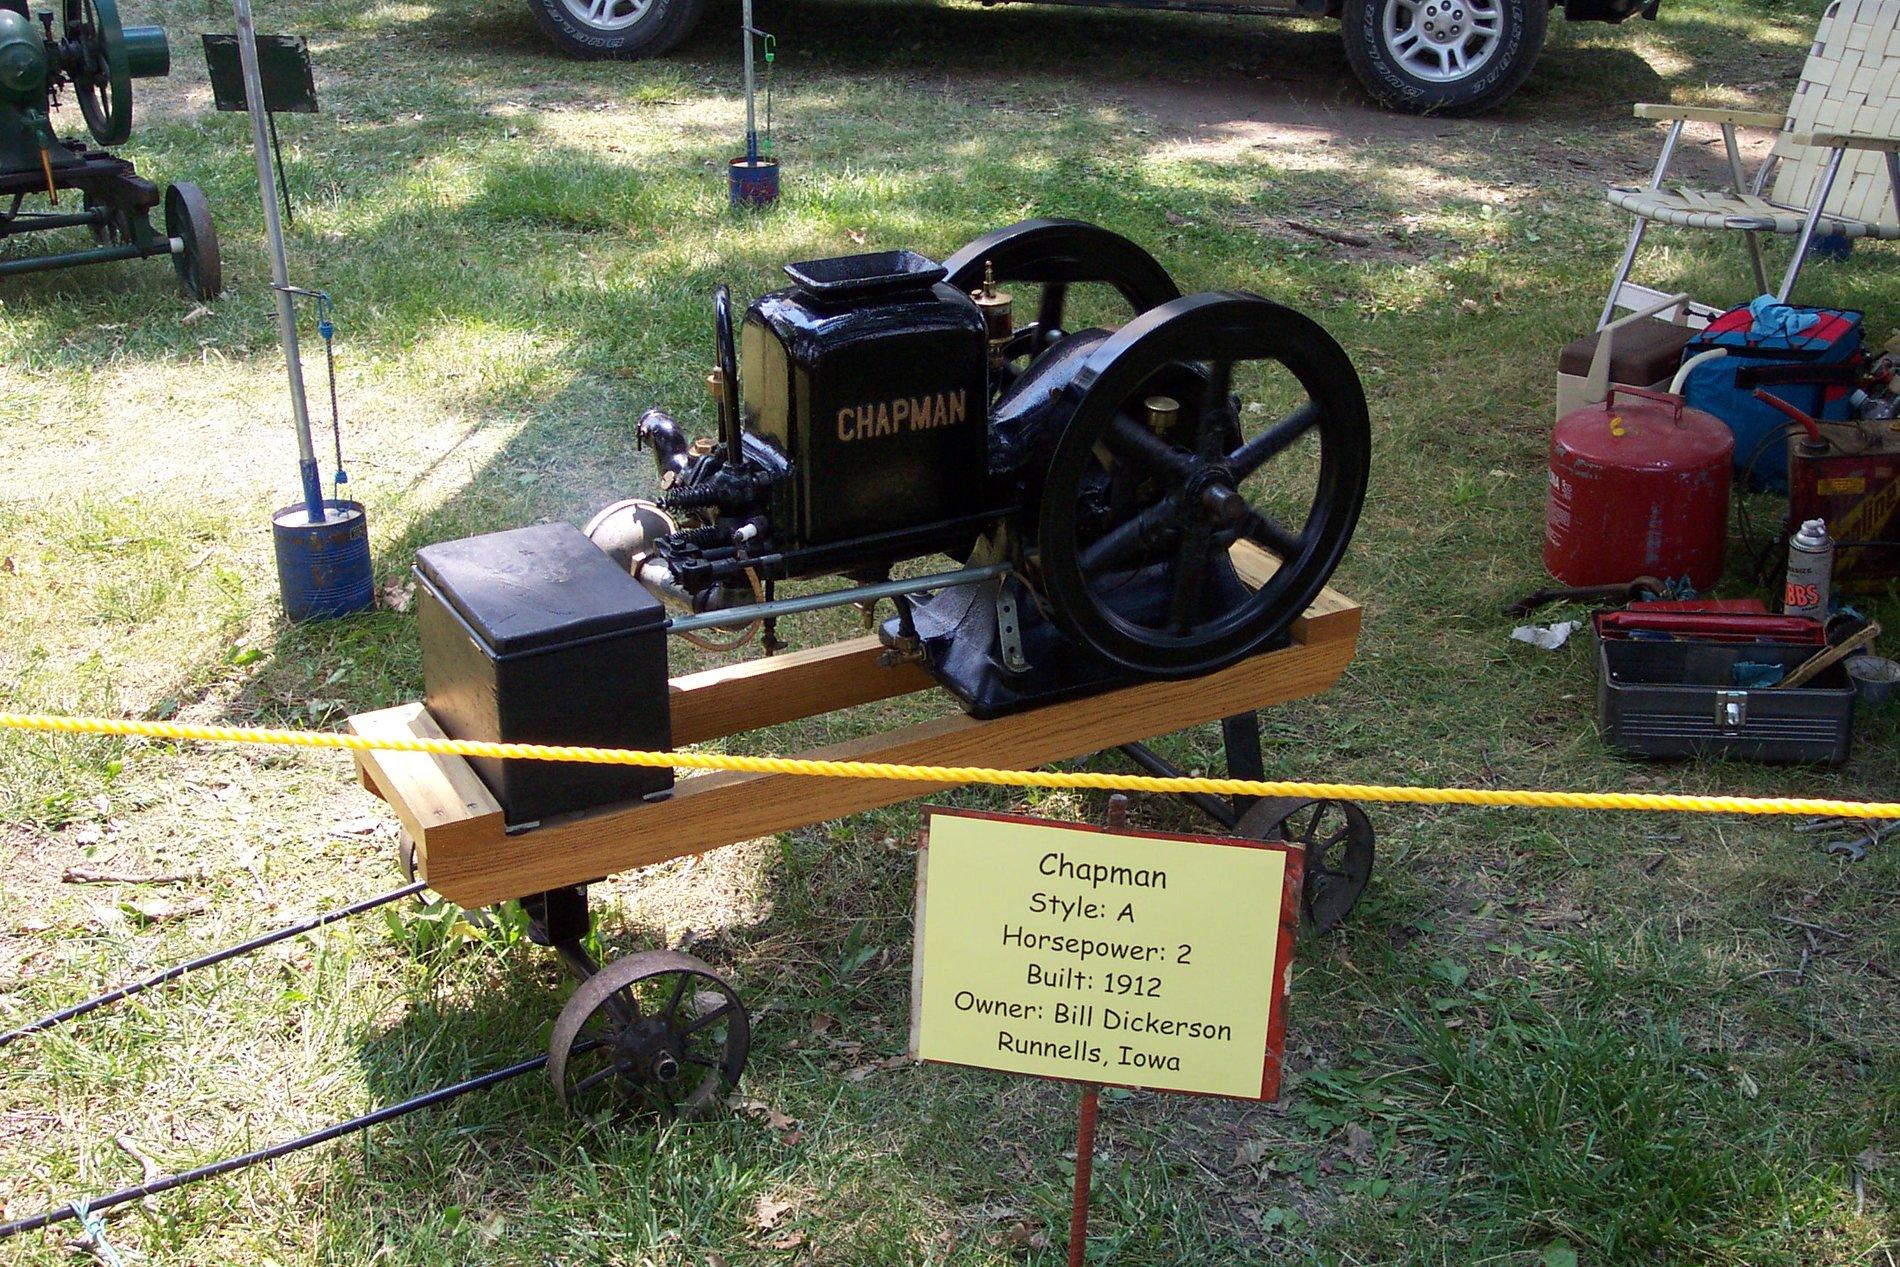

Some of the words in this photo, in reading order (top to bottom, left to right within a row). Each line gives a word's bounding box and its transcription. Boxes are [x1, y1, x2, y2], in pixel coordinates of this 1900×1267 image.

[837, 388, 967, 442] CHAPMAN
[1039, 852, 1167, 890] Chapman
[1029, 892, 1106, 923] Style:
[1116, 902, 1135, 924] A
[1002, 924, 1165, 962] Horsepower:
[1176, 943, 1192, 965] 2
[1027, 963, 1093, 991] Built:
[1104, 972, 1162, 998] 1912
[954, 990, 1043, 1020] Owner:
[1054, 1002, 1093, 1027] Bill
[1103, 1008, 1231, 1042] Dickerson
[998, 1030, 1108, 1068] Runnells,
[1117, 1045, 1180, 1072] Iowa
